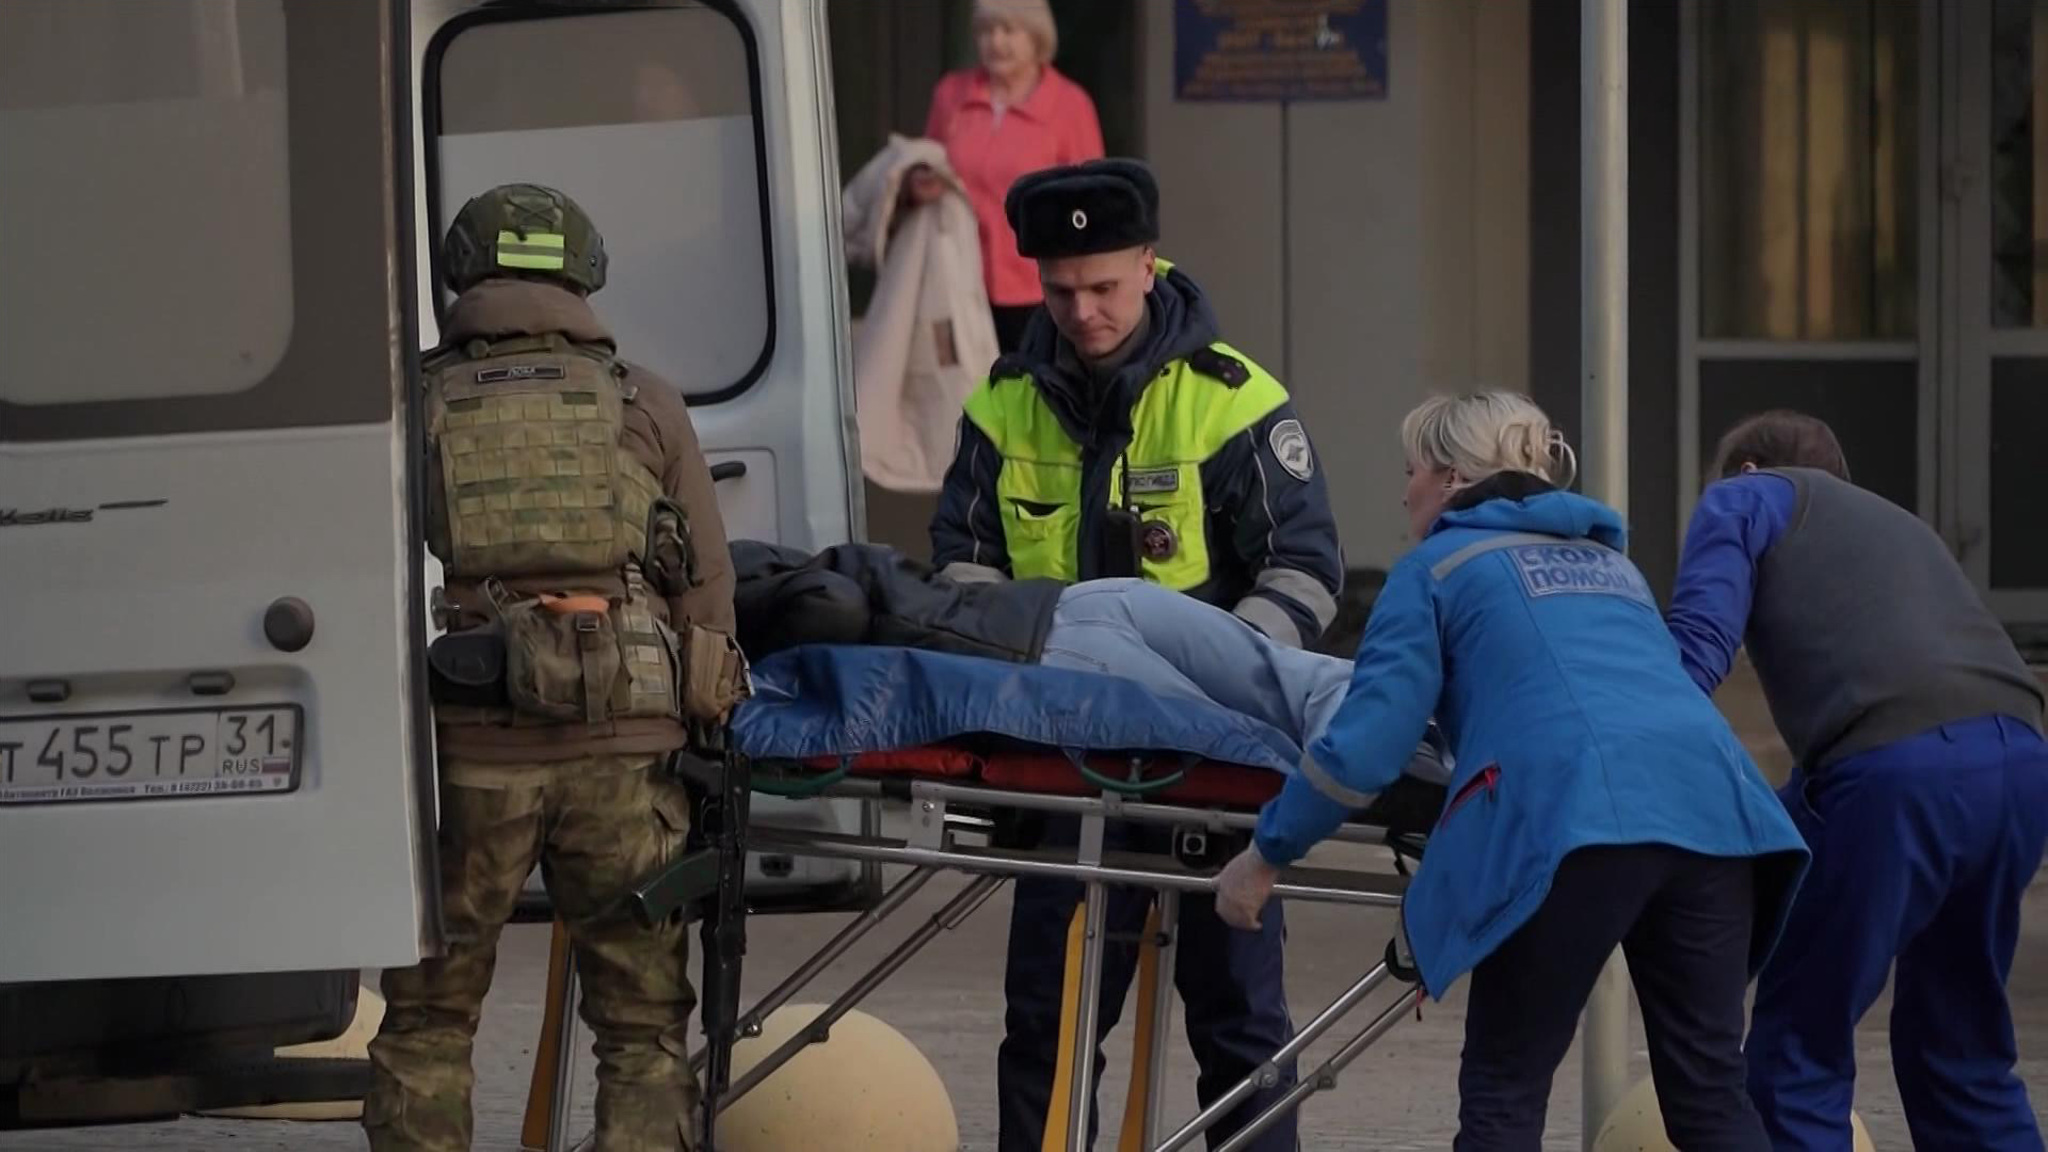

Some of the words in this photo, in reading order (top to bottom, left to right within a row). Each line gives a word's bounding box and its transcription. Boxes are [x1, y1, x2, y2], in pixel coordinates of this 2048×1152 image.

[37, 725, 133, 780] 455
[226, 714, 275, 756] 31
[222, 758, 261, 775] RUS
